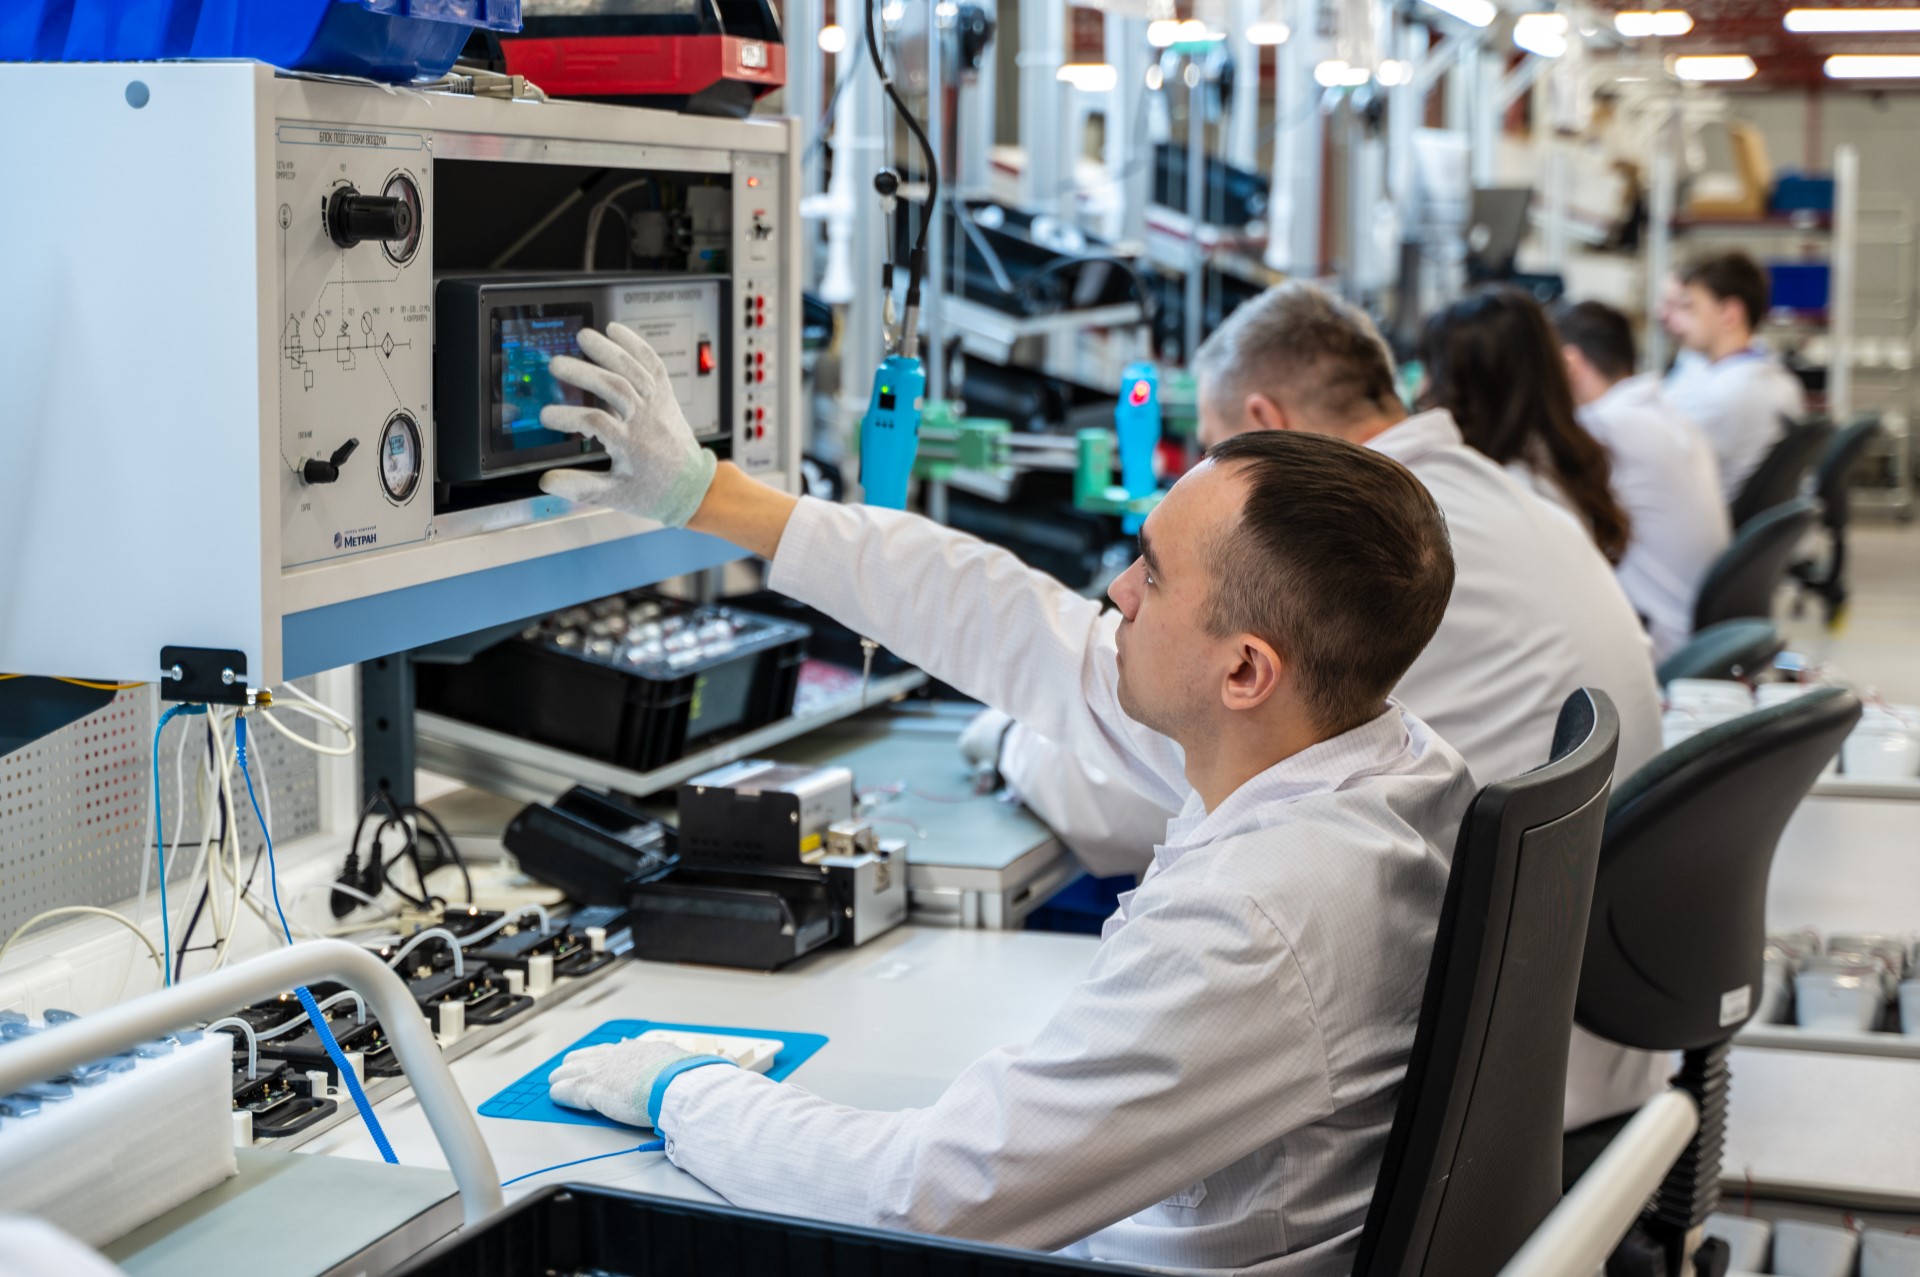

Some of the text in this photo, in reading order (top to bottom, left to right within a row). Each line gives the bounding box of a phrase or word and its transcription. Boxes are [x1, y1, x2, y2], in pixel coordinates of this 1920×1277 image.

[319, 131, 388, 146] БЛОК ПОДГОТОВКИ ВОЗДУХА
